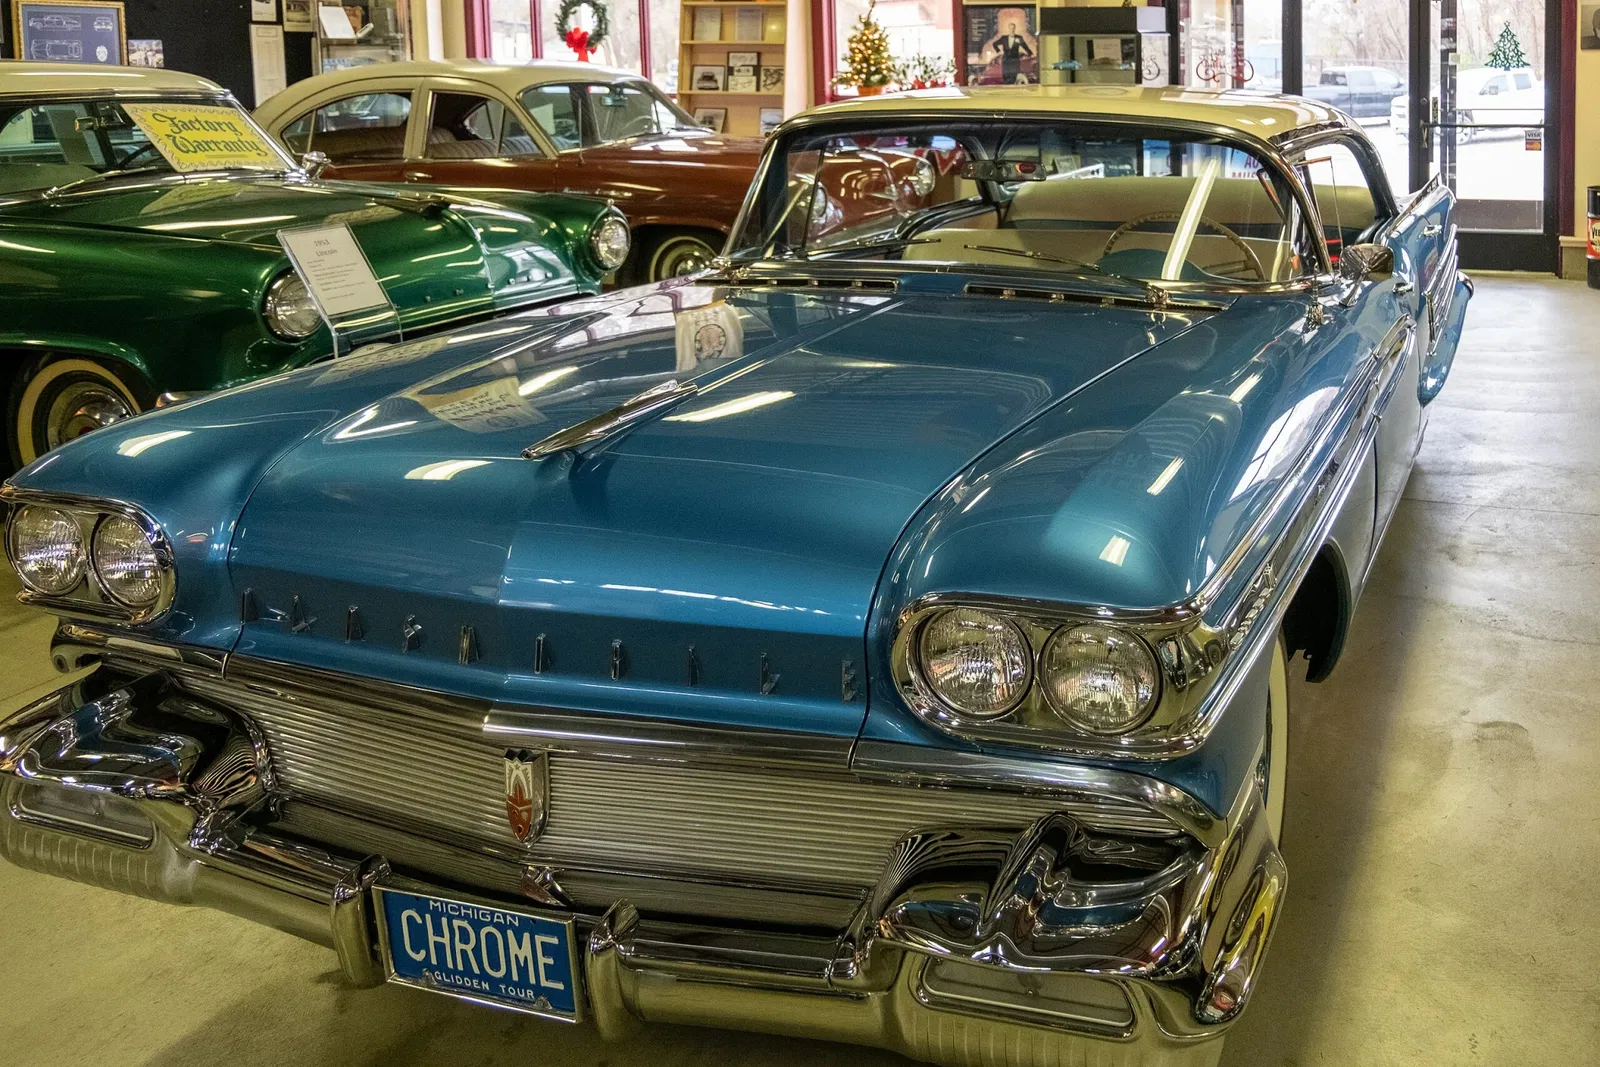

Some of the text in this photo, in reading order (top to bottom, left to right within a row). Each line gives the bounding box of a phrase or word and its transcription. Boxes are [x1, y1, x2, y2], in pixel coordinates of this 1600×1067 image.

[152, 112, 243, 136] Factory
[165, 132, 268, 157] Warranty
[315, 249, 338, 257] Lincoln
[429, 899, 519, 927] MICHIGAN
[400, 909, 565, 990] CHROME
[434, 970, 535, 1000] GLIDDEN TOUR
